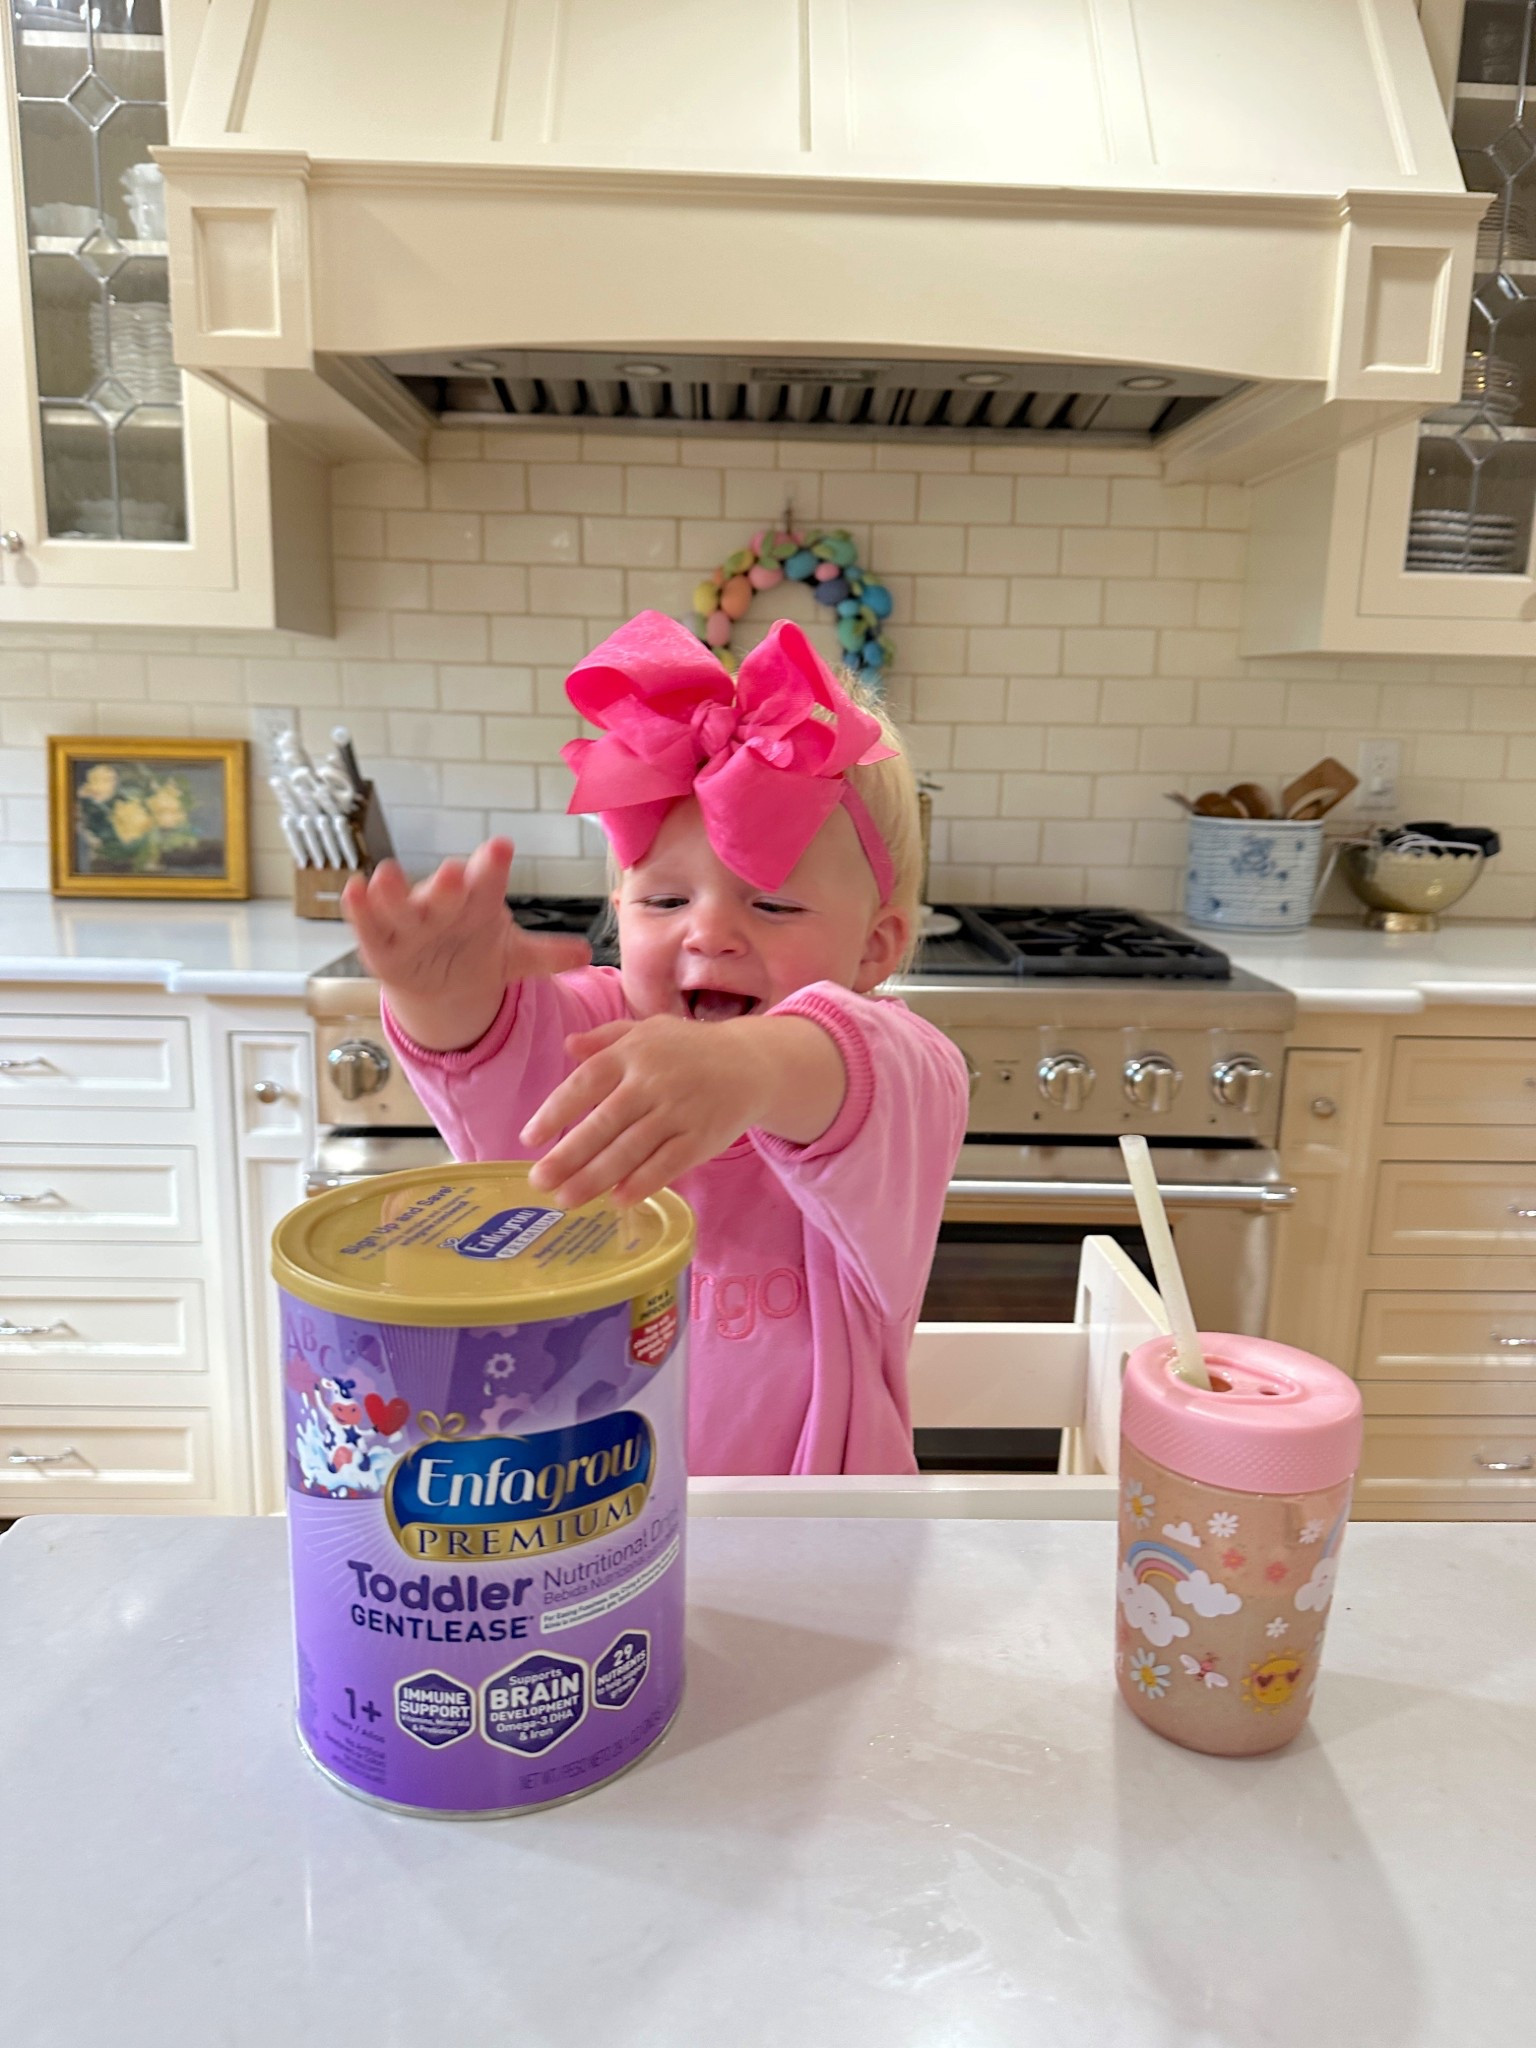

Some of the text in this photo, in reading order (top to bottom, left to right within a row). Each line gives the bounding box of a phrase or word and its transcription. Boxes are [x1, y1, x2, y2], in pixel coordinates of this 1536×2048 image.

[340, 1235, 380, 1254] Sign
[373, 1222, 399, 1234] Up
[396, 1207, 425, 1221] and
[464, 1209, 538, 1252] Enfagrow
[500, 1212, 560, 1256] PREMIUM
[417, 1434, 642, 1512] Enfagrow
[417, 1494, 634, 1555] PREMIUM
[347, 1560, 534, 1613] Toddler
[544, 1529, 648, 1590] Nutritional
[544, 1584, 588, 1605] Bebida
[597, 1649, 646, 1687] NUTRIENTS
[613, 1643, 633, 1667] 29
[490, 1672, 580, 1711] BRAIN
[509, 1668, 562, 1687] Supports
[344, 1687, 382, 1722] 1+
[400, 1701, 470, 1718] SUPPORT
[403, 1687, 466, 1705] IMMUNE
[490, 1695, 580, 1722] DEVELOPMENT
[496, 1708, 574, 1733] Omega-3 DHA
[519, 1728, 553, 1741] & Iron
